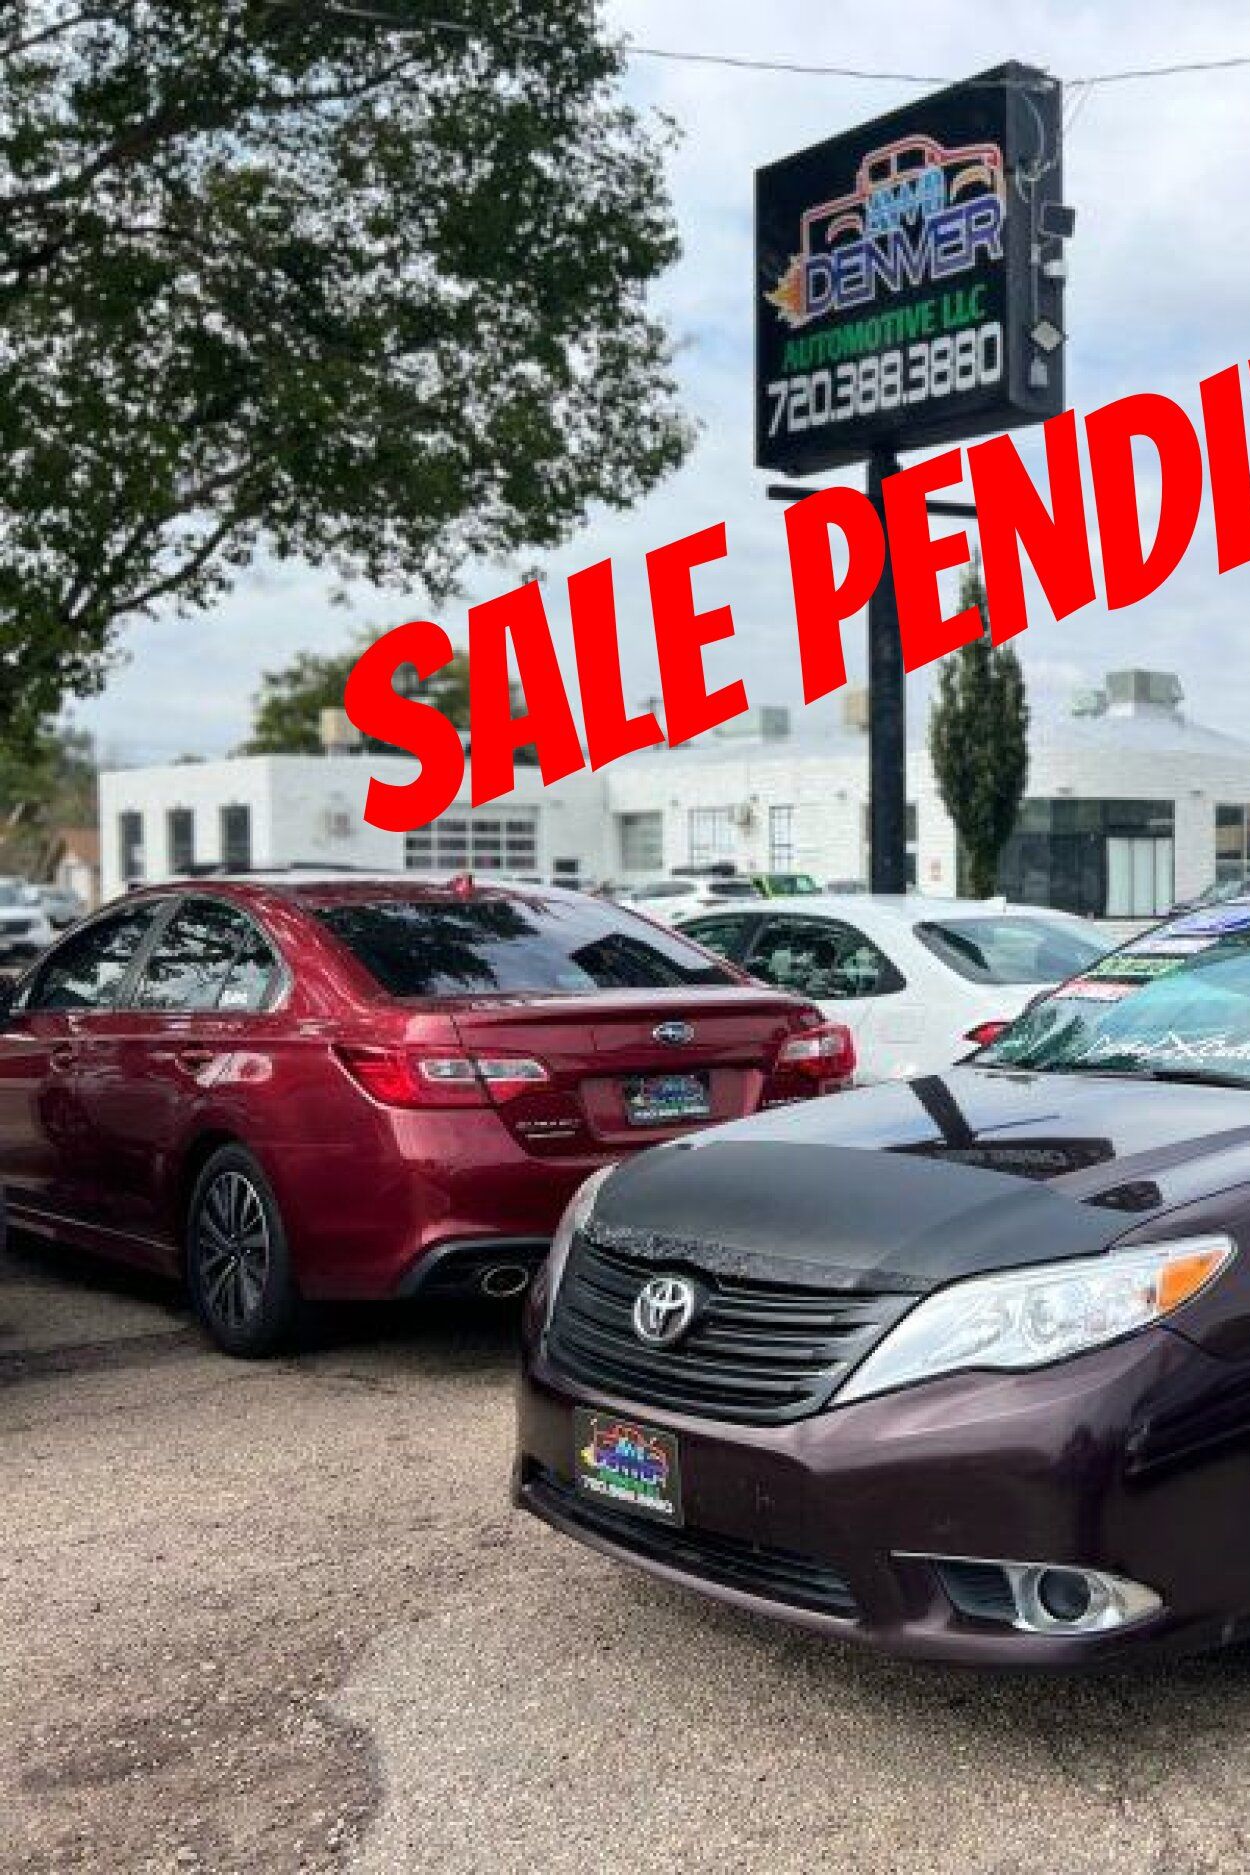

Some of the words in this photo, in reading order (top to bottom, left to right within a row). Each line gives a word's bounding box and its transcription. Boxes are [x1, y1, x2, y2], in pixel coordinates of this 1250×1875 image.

[803, 193, 1004, 319] DENVER
[767, 321, 1002, 438] 720.388.3880
[781, 304, 937, 373] AUTOMOTIVE
[942, 283, 988, 325] LLC
